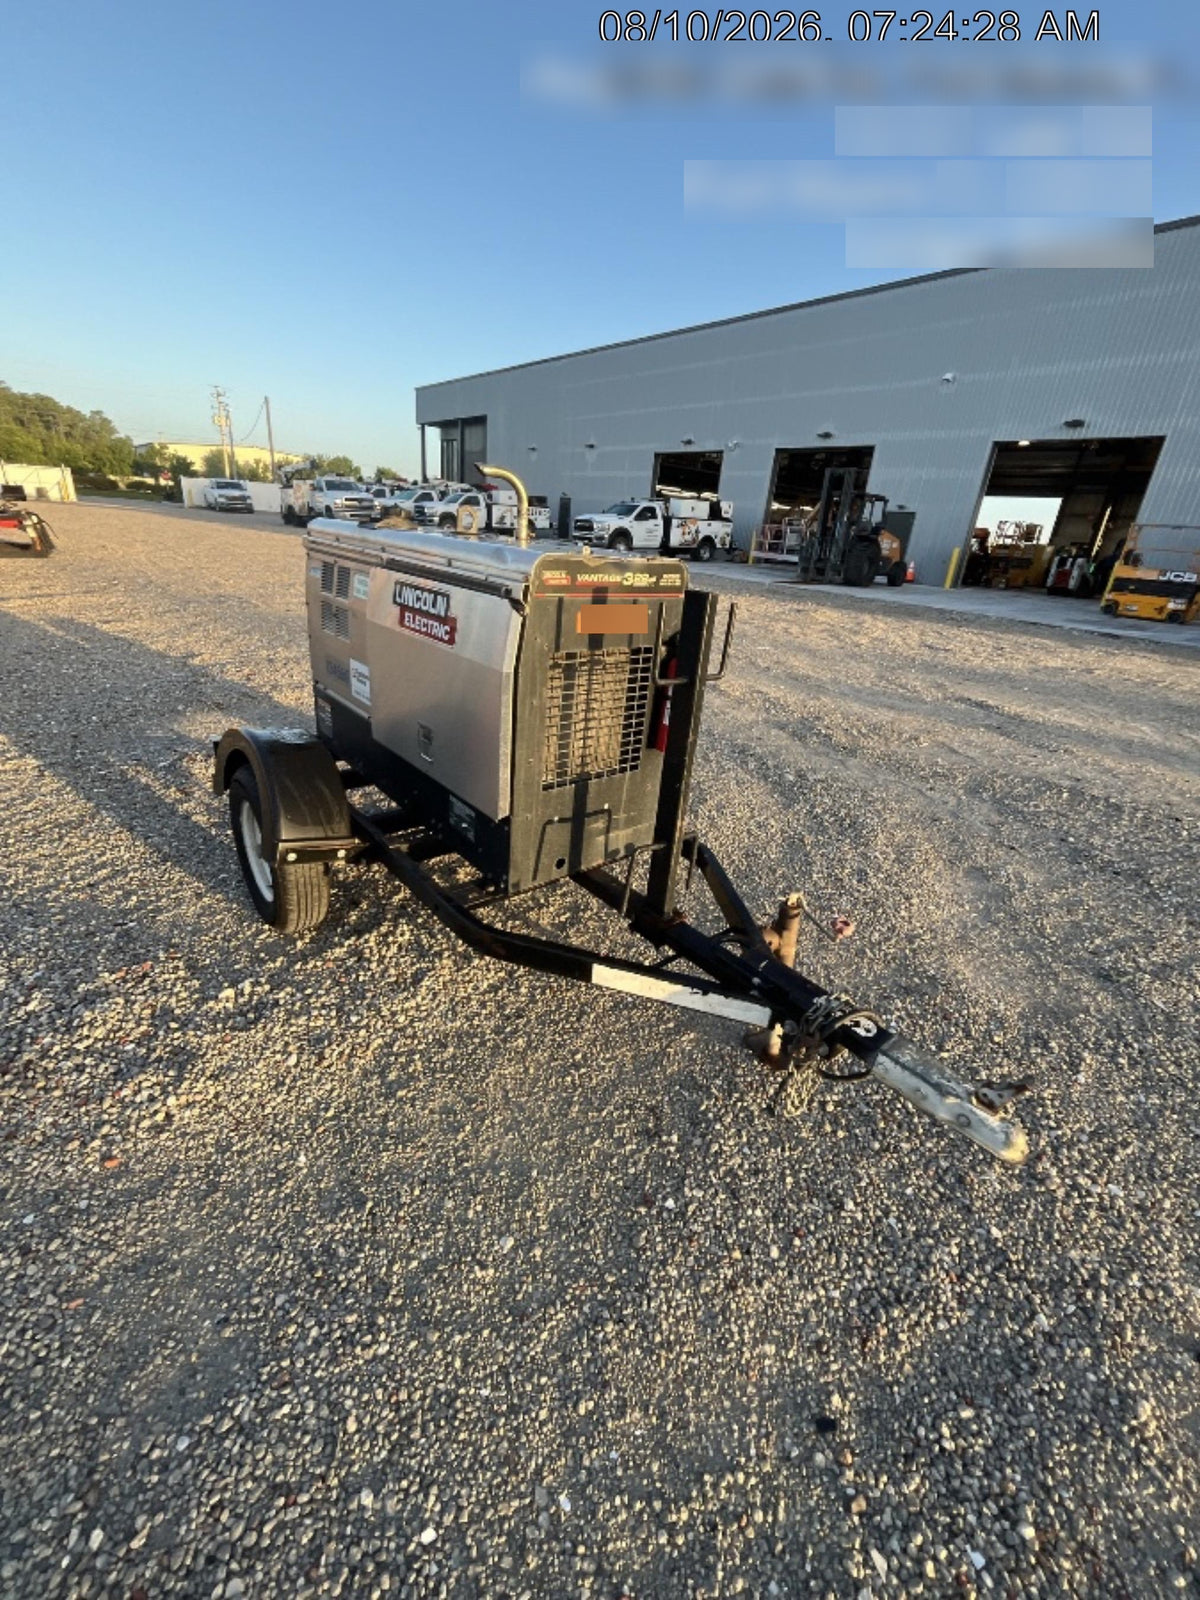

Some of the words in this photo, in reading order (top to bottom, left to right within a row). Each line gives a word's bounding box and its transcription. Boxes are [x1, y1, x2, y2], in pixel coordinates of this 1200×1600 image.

[1159, 570, 1197, 582] JCB
[395, 584, 447, 617] LINCOLN
[404, 611, 450, 640] ELECTRIC
